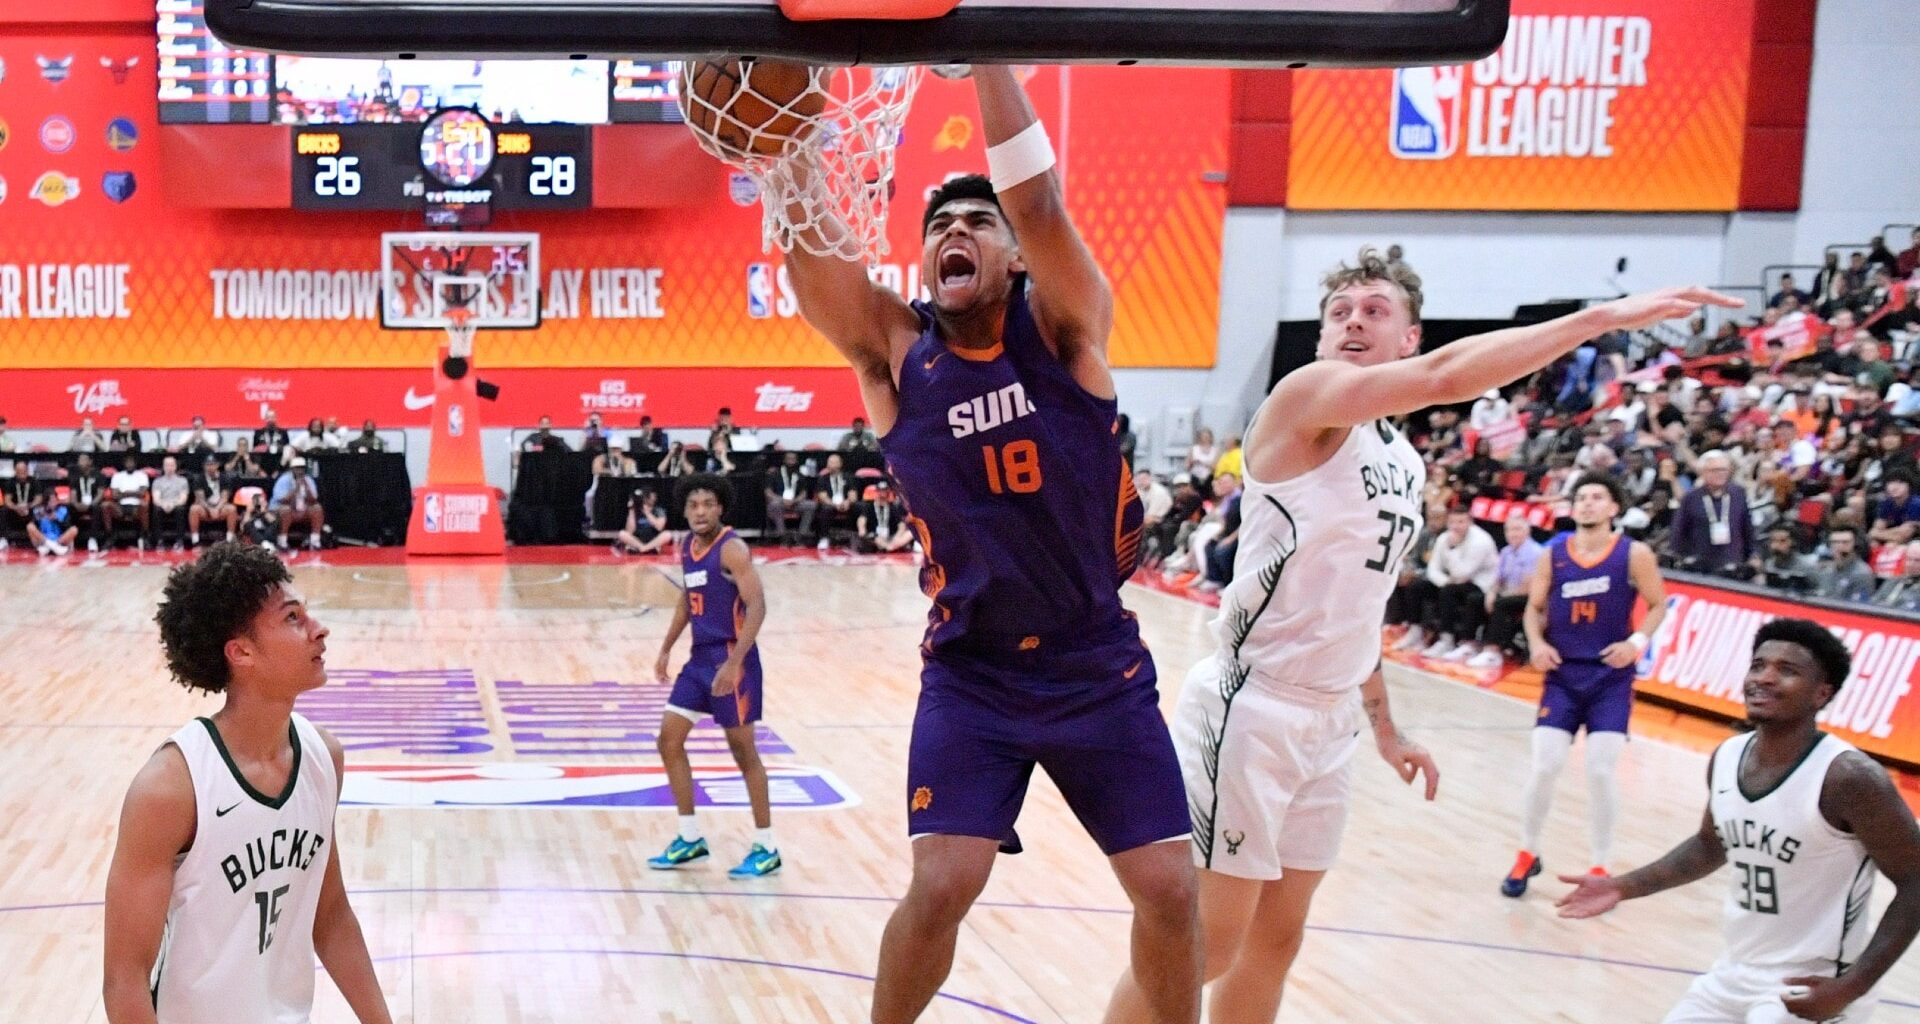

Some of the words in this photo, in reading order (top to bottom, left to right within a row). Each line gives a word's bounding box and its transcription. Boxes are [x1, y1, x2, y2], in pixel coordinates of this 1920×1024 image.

[1467, 87, 1617, 156] LEAGUE
[315, 157, 360, 195] 26
[530, 157, 575, 195] 28
[27, 264, 130, 318] LEAGUE
[590, 268, 665, 318] HERE
[580, 393, 645, 408] TISSOT
[982, 439, 1042, 494] 18
[1360, 463, 1422, 506] BUCK
[1365, 510, 1415, 575] 37
[689, 592, 704, 616] 51
[1571, 601, 1597, 624] 14
[220, 828, 325, 894] BUCKS
[1714, 819, 1801, 864] UCKS
[1735, 861, 1779, 915] 39
[254, 883, 290, 955] 15
